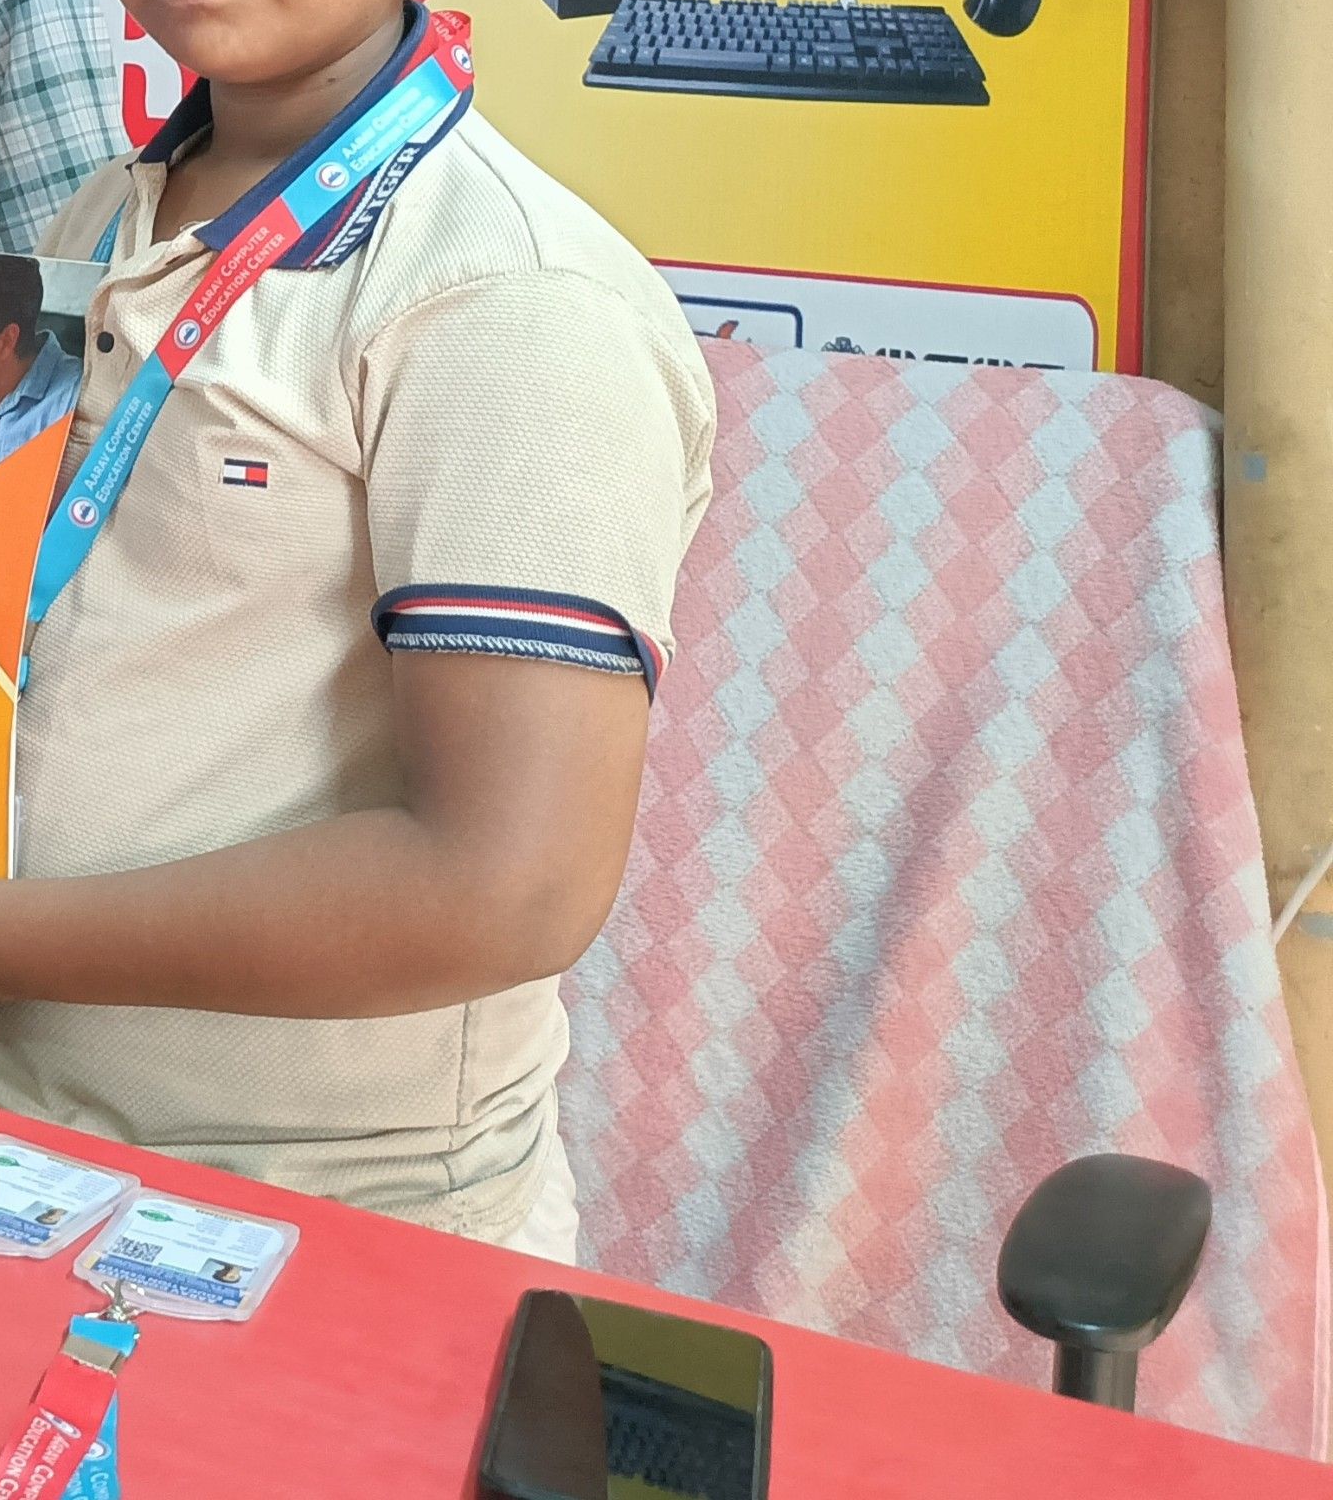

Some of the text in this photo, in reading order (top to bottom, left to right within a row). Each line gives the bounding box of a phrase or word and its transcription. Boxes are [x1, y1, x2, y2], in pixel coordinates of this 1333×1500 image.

[194, 226, 271, 314] AARAV COMPUTER
[200, 233, 286, 327] EDUCATION CENTER
[83, 396, 142, 492] AARAV COMPUTER
[95, 402, 154, 504] EDUCATION CENTER
